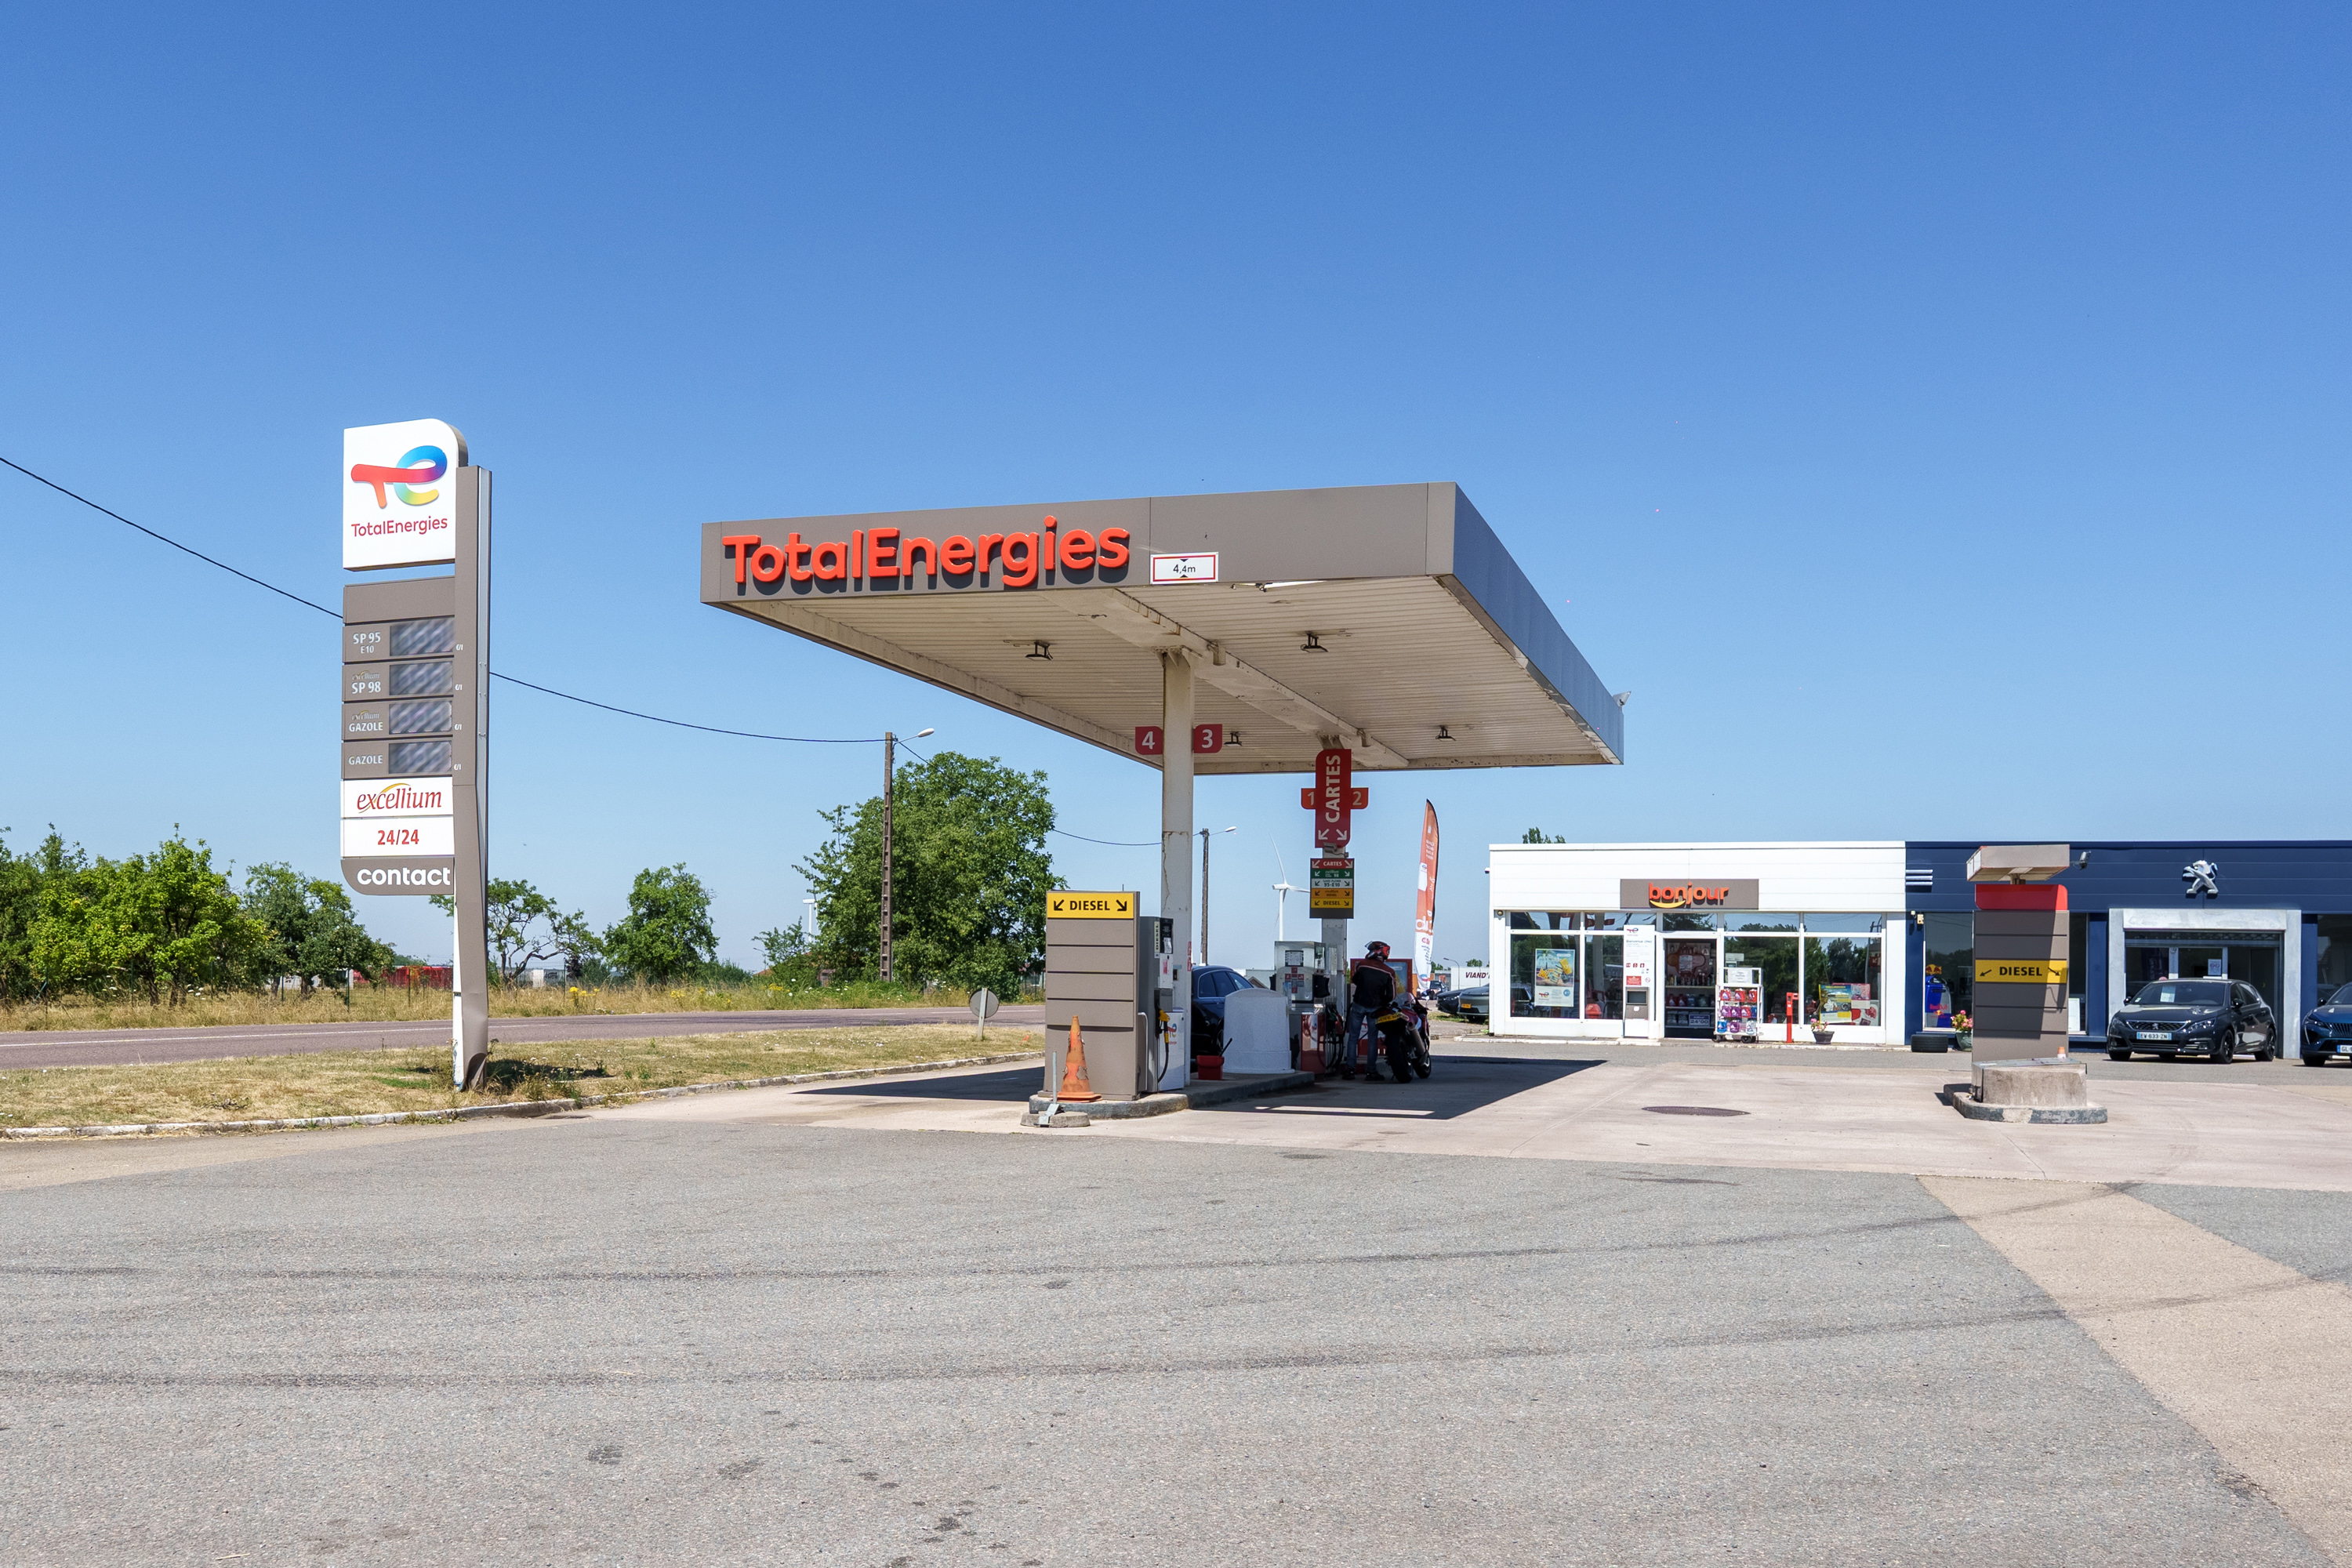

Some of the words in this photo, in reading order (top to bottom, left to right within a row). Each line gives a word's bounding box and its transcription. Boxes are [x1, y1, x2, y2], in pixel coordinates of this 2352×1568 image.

[350, 515, 448, 537] TotalEnergies
[722, 514, 1131, 587] TotalEnergies
[1173, 564, 1196, 575] 4,4m
[353, 633, 366, 644] SP
[368, 632, 381, 643] 95
[360, 645, 375, 654] E10
[351, 682, 365, 694] SP
[368, 681, 381, 693] 98
[349, 721, 383, 732] GAZOLE
[1142, 731, 1156, 750] 4
[1201, 729, 1214, 749] 3
[348, 754, 383, 765] GAZOLE
[1326, 754, 1341, 823] CARTES
[357, 787, 441, 810] excellium
[1307, 792, 1315, 806] 1
[1352, 791, 1363, 806] 2
[377, 829, 419, 845] 24/24
[357, 867, 451, 886] contact
[1649, 882, 1730, 905] bonjour
[1069, 901, 1110, 910] DIESEL
[1999, 967, 2042, 976] DIESEL
